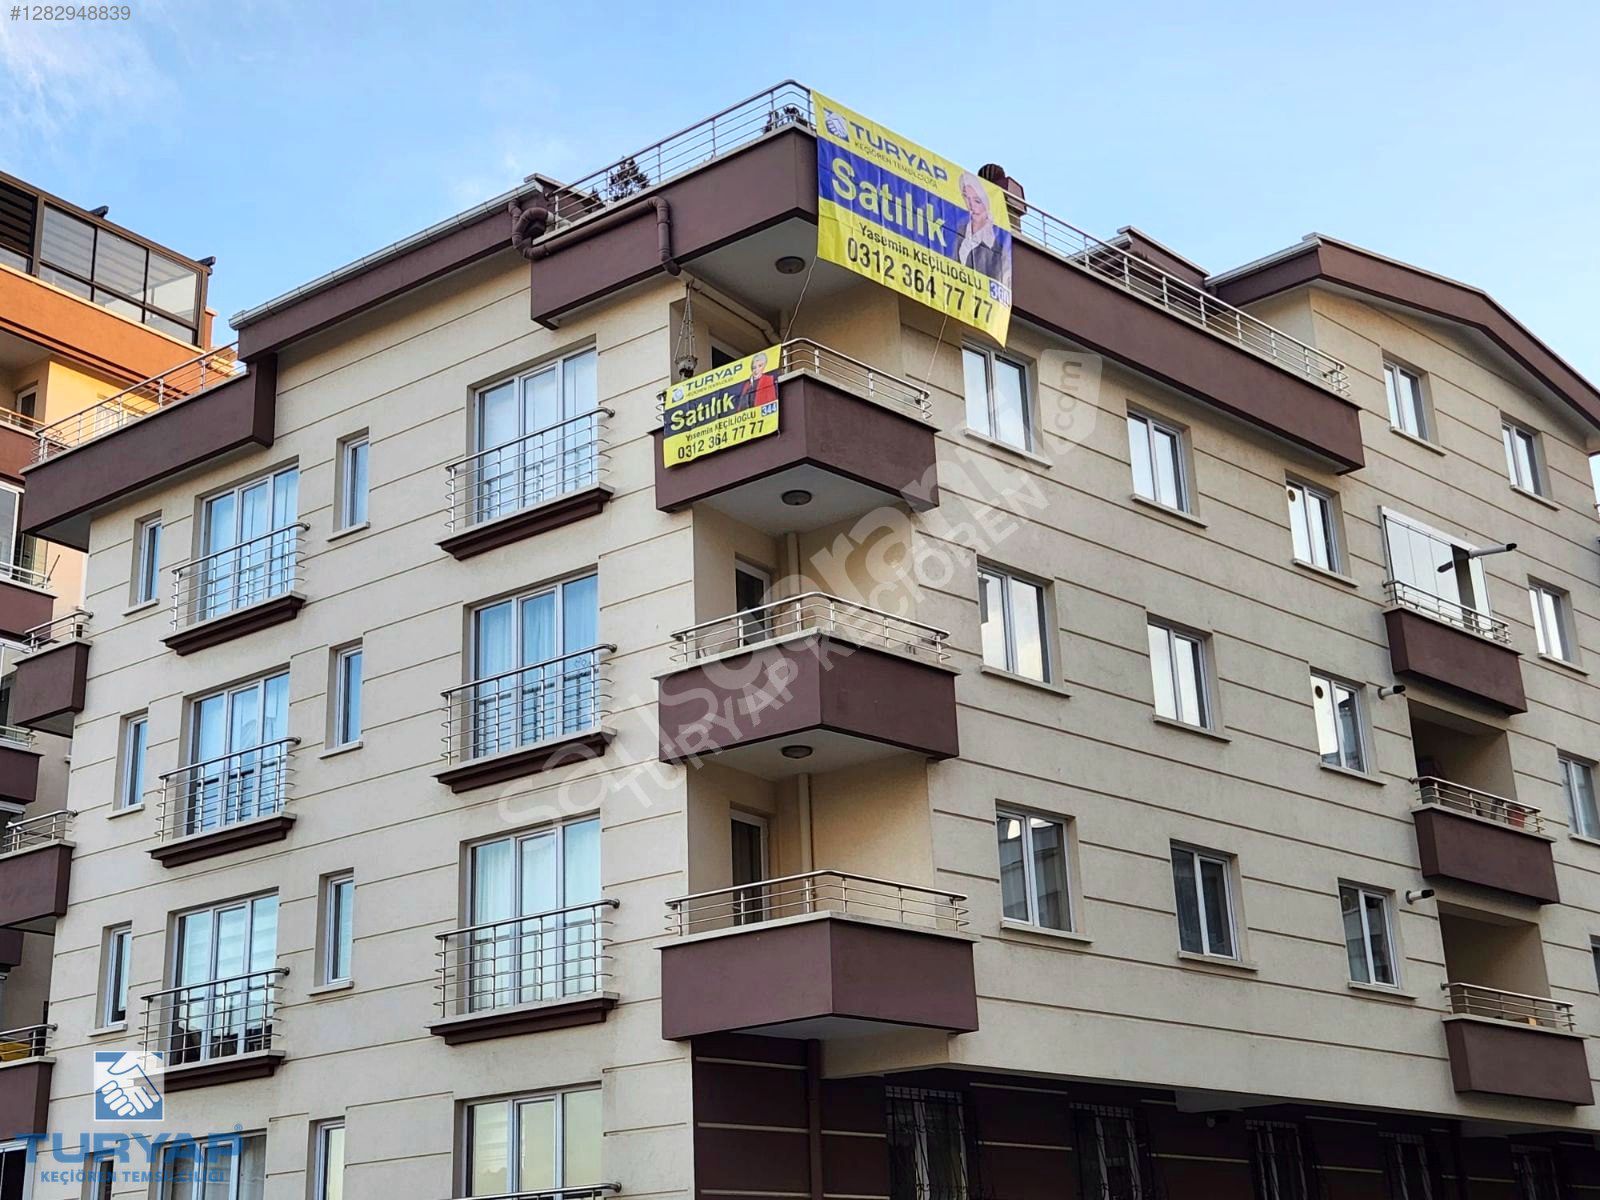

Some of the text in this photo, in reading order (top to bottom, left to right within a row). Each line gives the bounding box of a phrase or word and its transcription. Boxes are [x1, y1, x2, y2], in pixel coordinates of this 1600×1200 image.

[850, 121, 948, 182] TURYAP
[831, 157, 947, 248] Satılık
[859, 222, 909, 257] Yasemin
[847, 237, 993, 323] 0312 364 77 77
[686, 363, 743, 391] TURYAP
[677, 419, 764, 460] 0312 364 77 77
